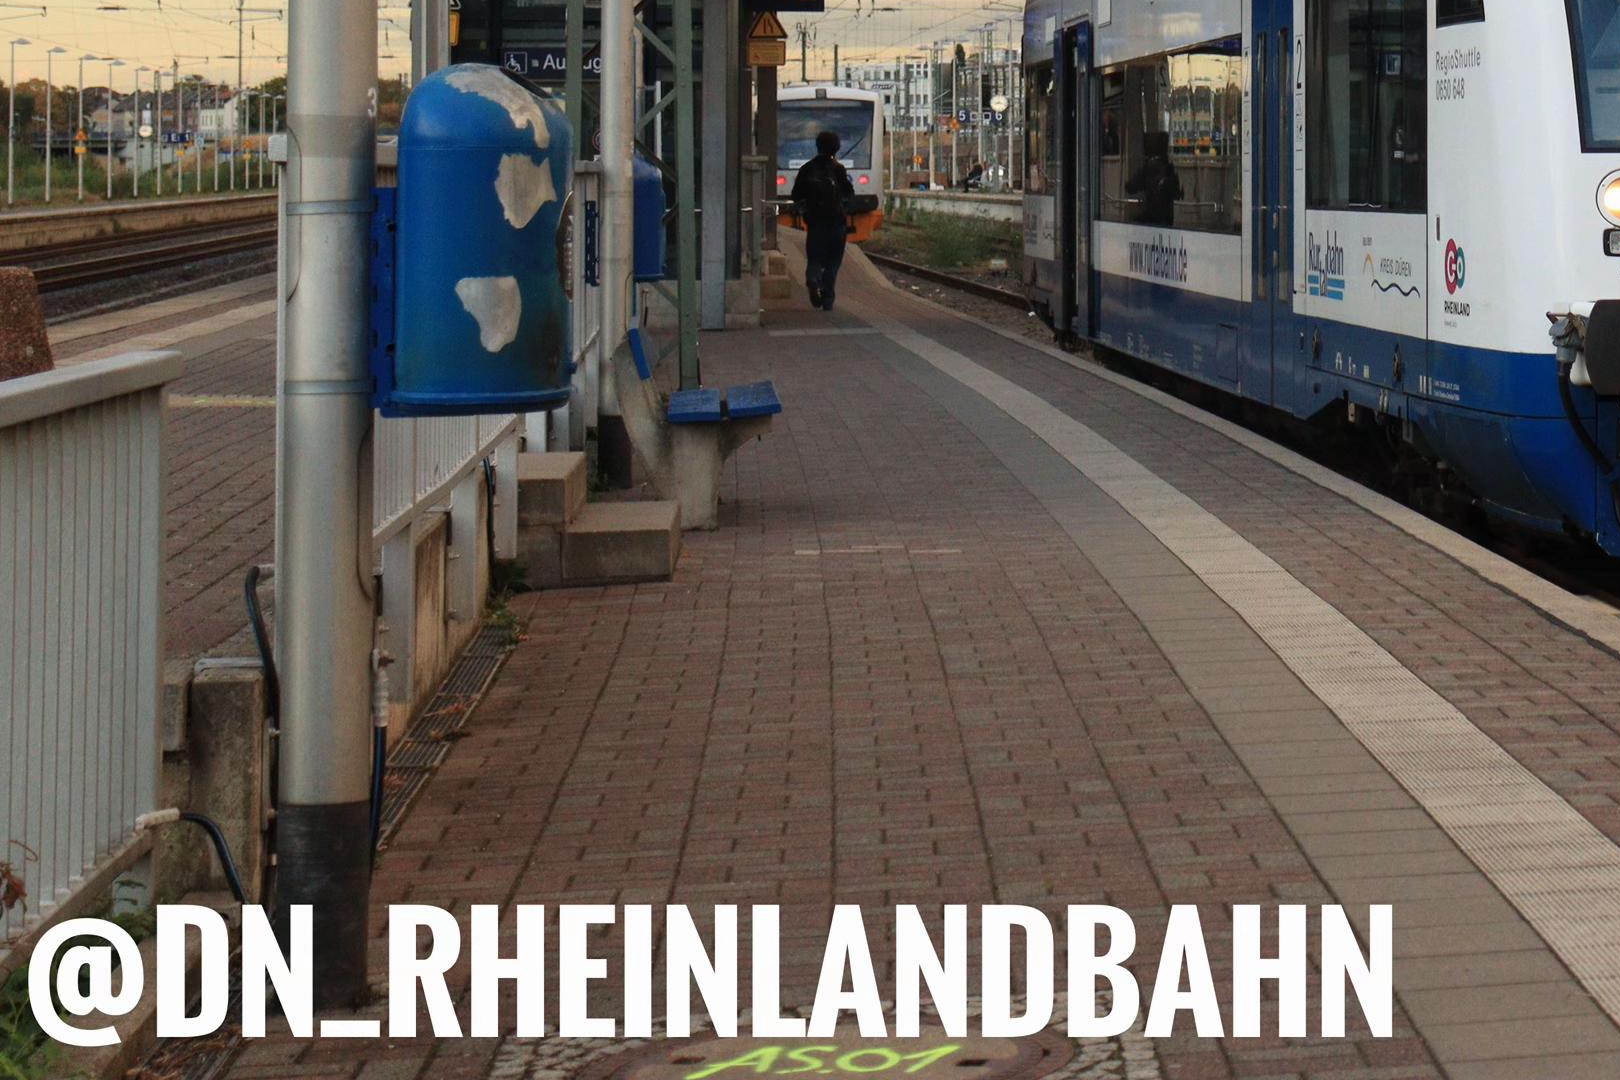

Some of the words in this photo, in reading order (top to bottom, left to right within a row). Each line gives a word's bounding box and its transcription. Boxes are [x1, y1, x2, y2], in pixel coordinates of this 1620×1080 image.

[1296, 38, 1303, 89] 2
[1435, 47, 1481, 76] RegioShuttle
[1435, 79, 1451, 101] 0650
[1452, 77, 1465, 100] 648
[1128, 233, 1187, 283] www.rurtalbahn.de
[1380, 257, 1394, 274] KREIS
[1394, 256, 1412, 277] DÜREN
[1444, 300, 1471, 317] RHEINLAND
